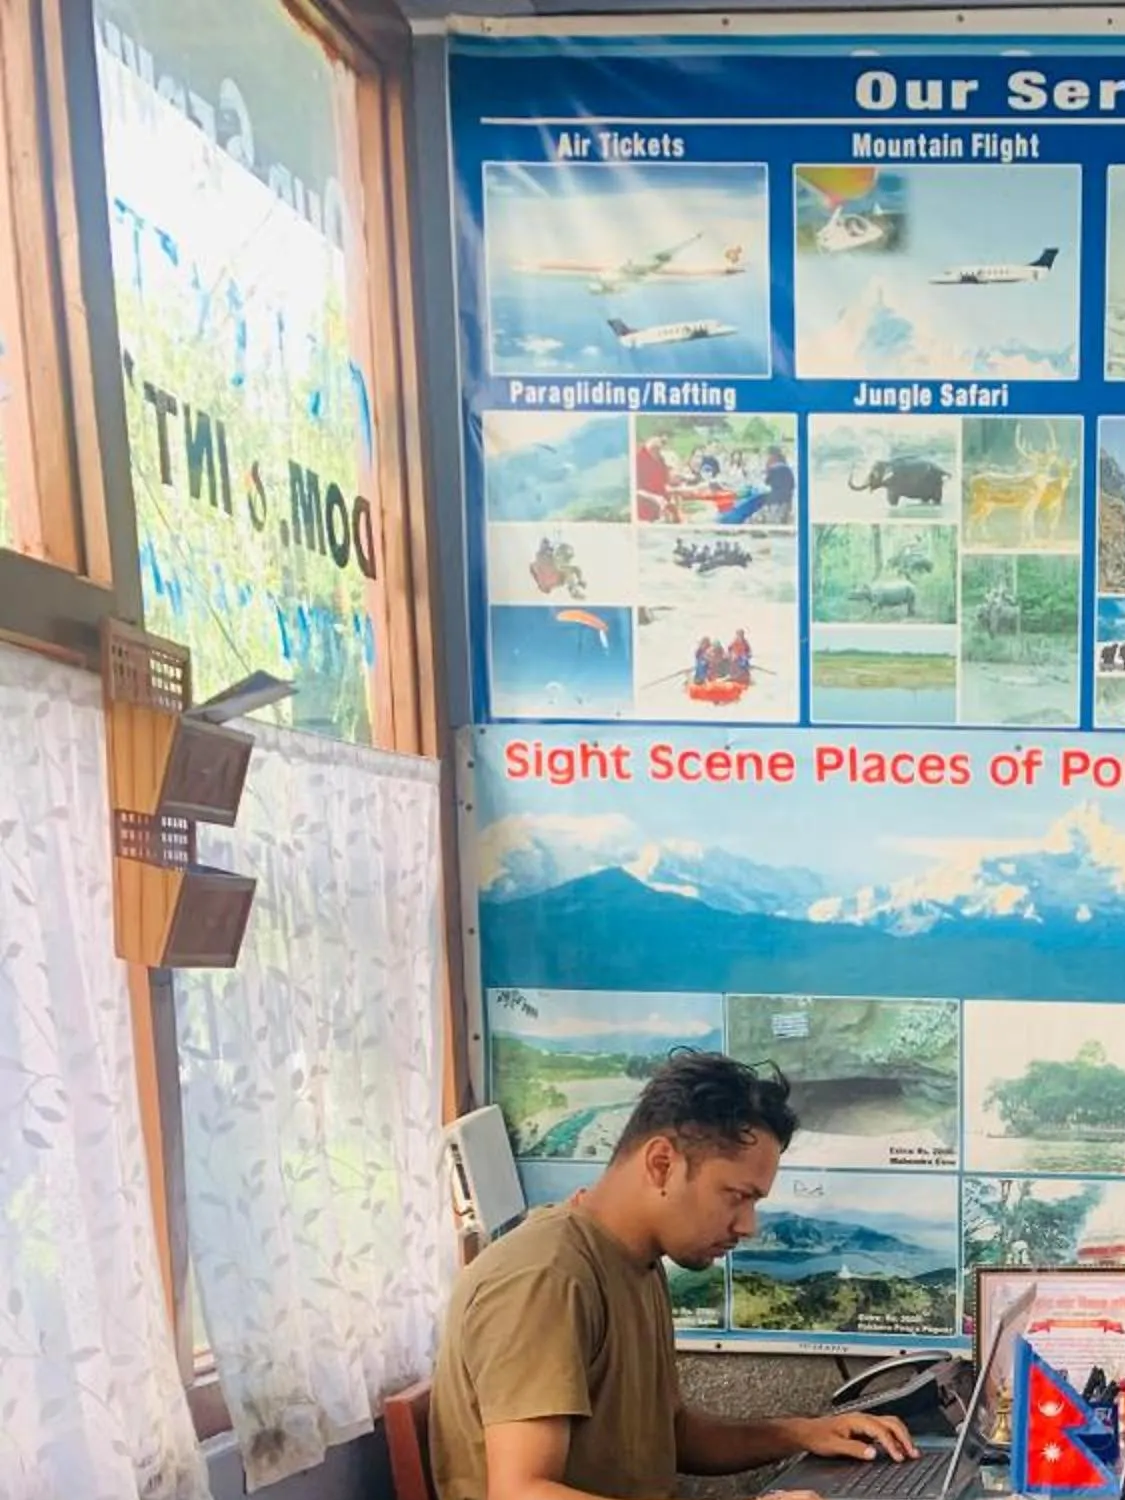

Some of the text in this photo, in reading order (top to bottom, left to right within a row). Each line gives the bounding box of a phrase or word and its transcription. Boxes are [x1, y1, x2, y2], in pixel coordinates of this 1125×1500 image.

[854, 70, 980, 112] Our
[557, 132, 686, 159] Air Tickets
[851, 132, 1041, 164] Mountain Flight
[509, 381, 738, 412] Paragliding/Rafting
[853, 383, 1010, 410] Jungle Safari
[505, 743, 631, 787] Sight
[649, 745, 795, 783] Scene
[815, 748, 971, 786] Places
[989, 749, 1043, 787] of
